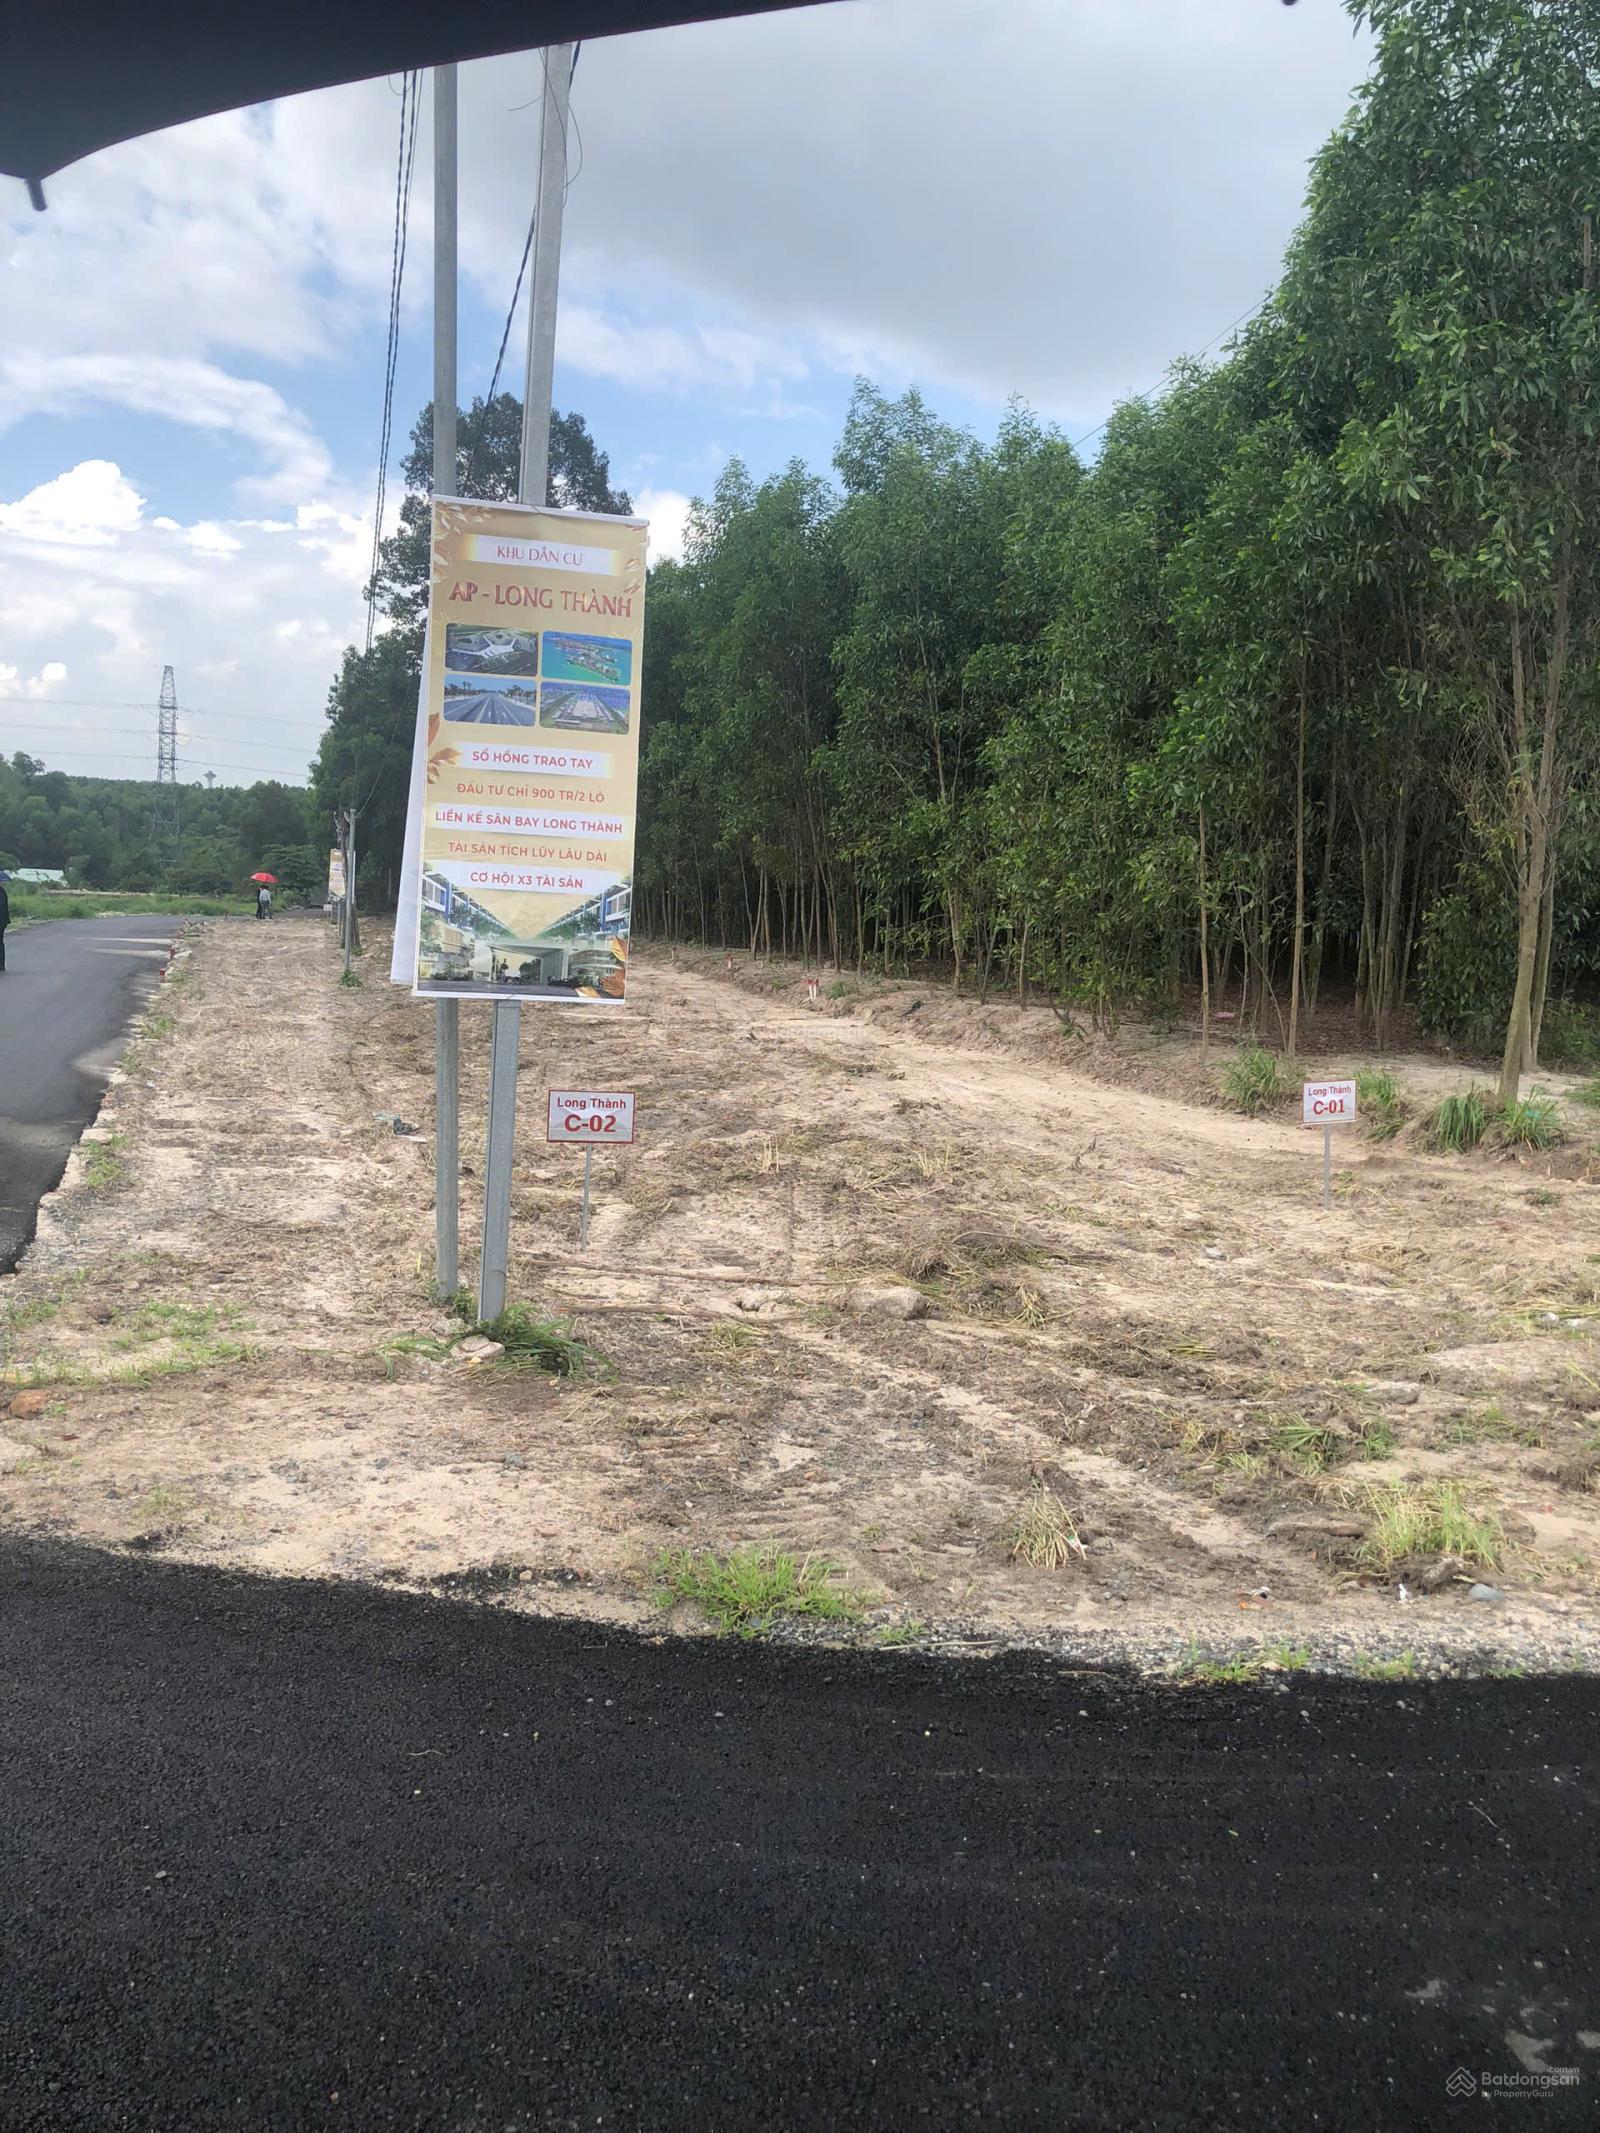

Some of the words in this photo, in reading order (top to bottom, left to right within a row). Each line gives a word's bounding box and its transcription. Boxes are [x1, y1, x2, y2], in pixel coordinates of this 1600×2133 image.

[497, 544, 525, 560] KHU
[450, 580, 478, 602] AP
[494, 584, 553, 609] LONG
[560, 588, 632, 618] THÀNH
[533, 754, 567, 767] TRAO
[571, 758, 594, 769] TAY
[532, 787, 555, 800] 900
[560, 789, 586, 803] TR/2
[515, 815, 540, 828] BAY
[543, 818, 577, 831] LONG
[470, 871, 488, 883] CƠ
[518, 874, 533, 885] X3
[1308, 1087, 1327, 1097] Long
[557, 1097, 587, 1110] Long
[590, 1097, 627, 1110] Thành
[1312, 1099, 1346, 1115] C-01
[564, 1113, 617, 1133] C-02
